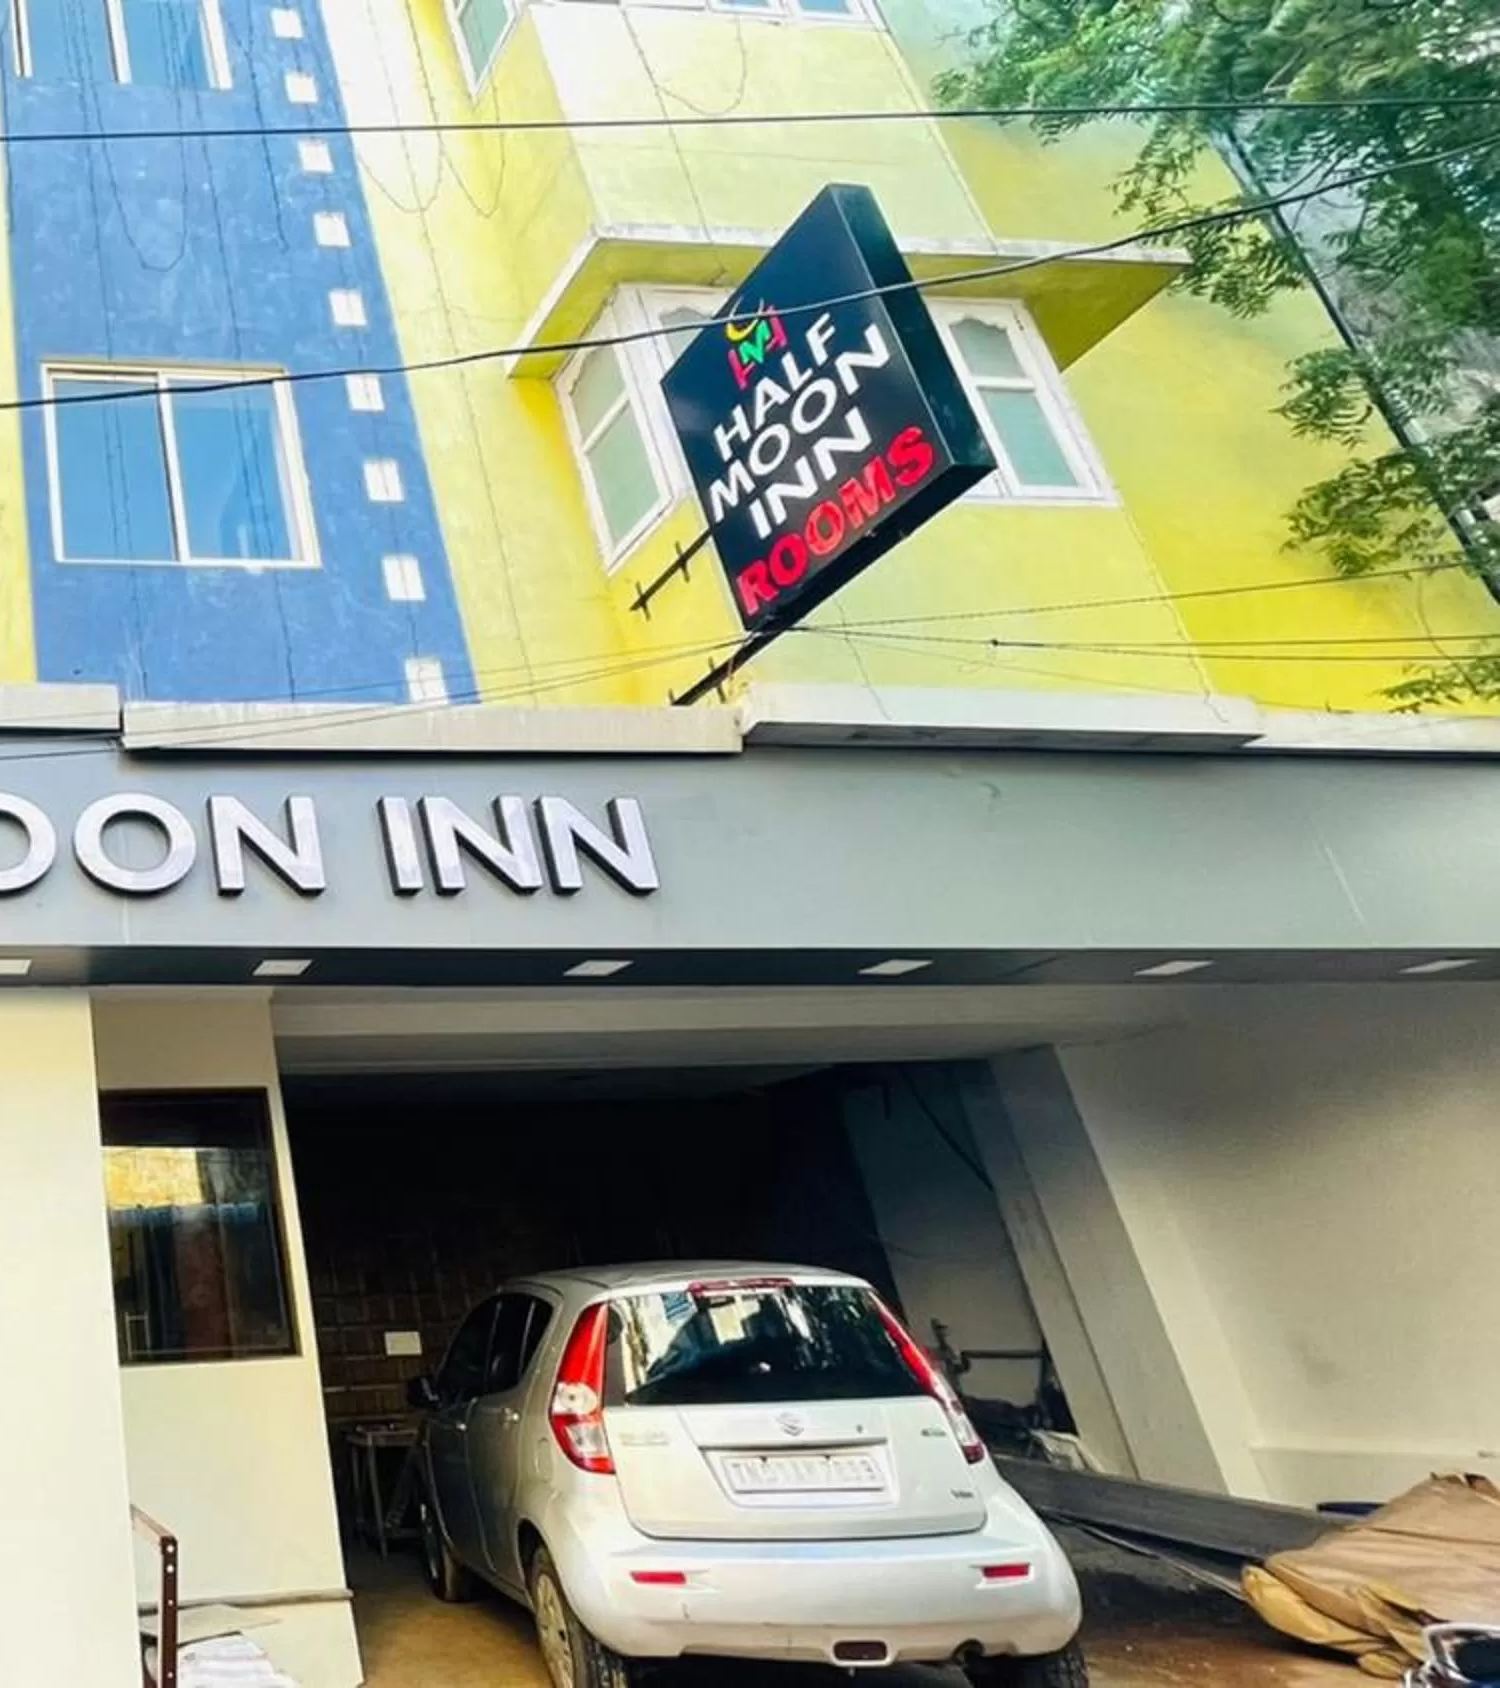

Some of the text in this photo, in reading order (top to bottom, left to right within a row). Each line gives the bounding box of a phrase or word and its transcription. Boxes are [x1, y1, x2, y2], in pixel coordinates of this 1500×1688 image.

[708, 323, 891, 524] MOON
[714, 312, 837, 463] HALF
[735, 426, 934, 616] ROOMS
[748, 408, 873, 540] INN
[377, 794, 660, 898] INN
